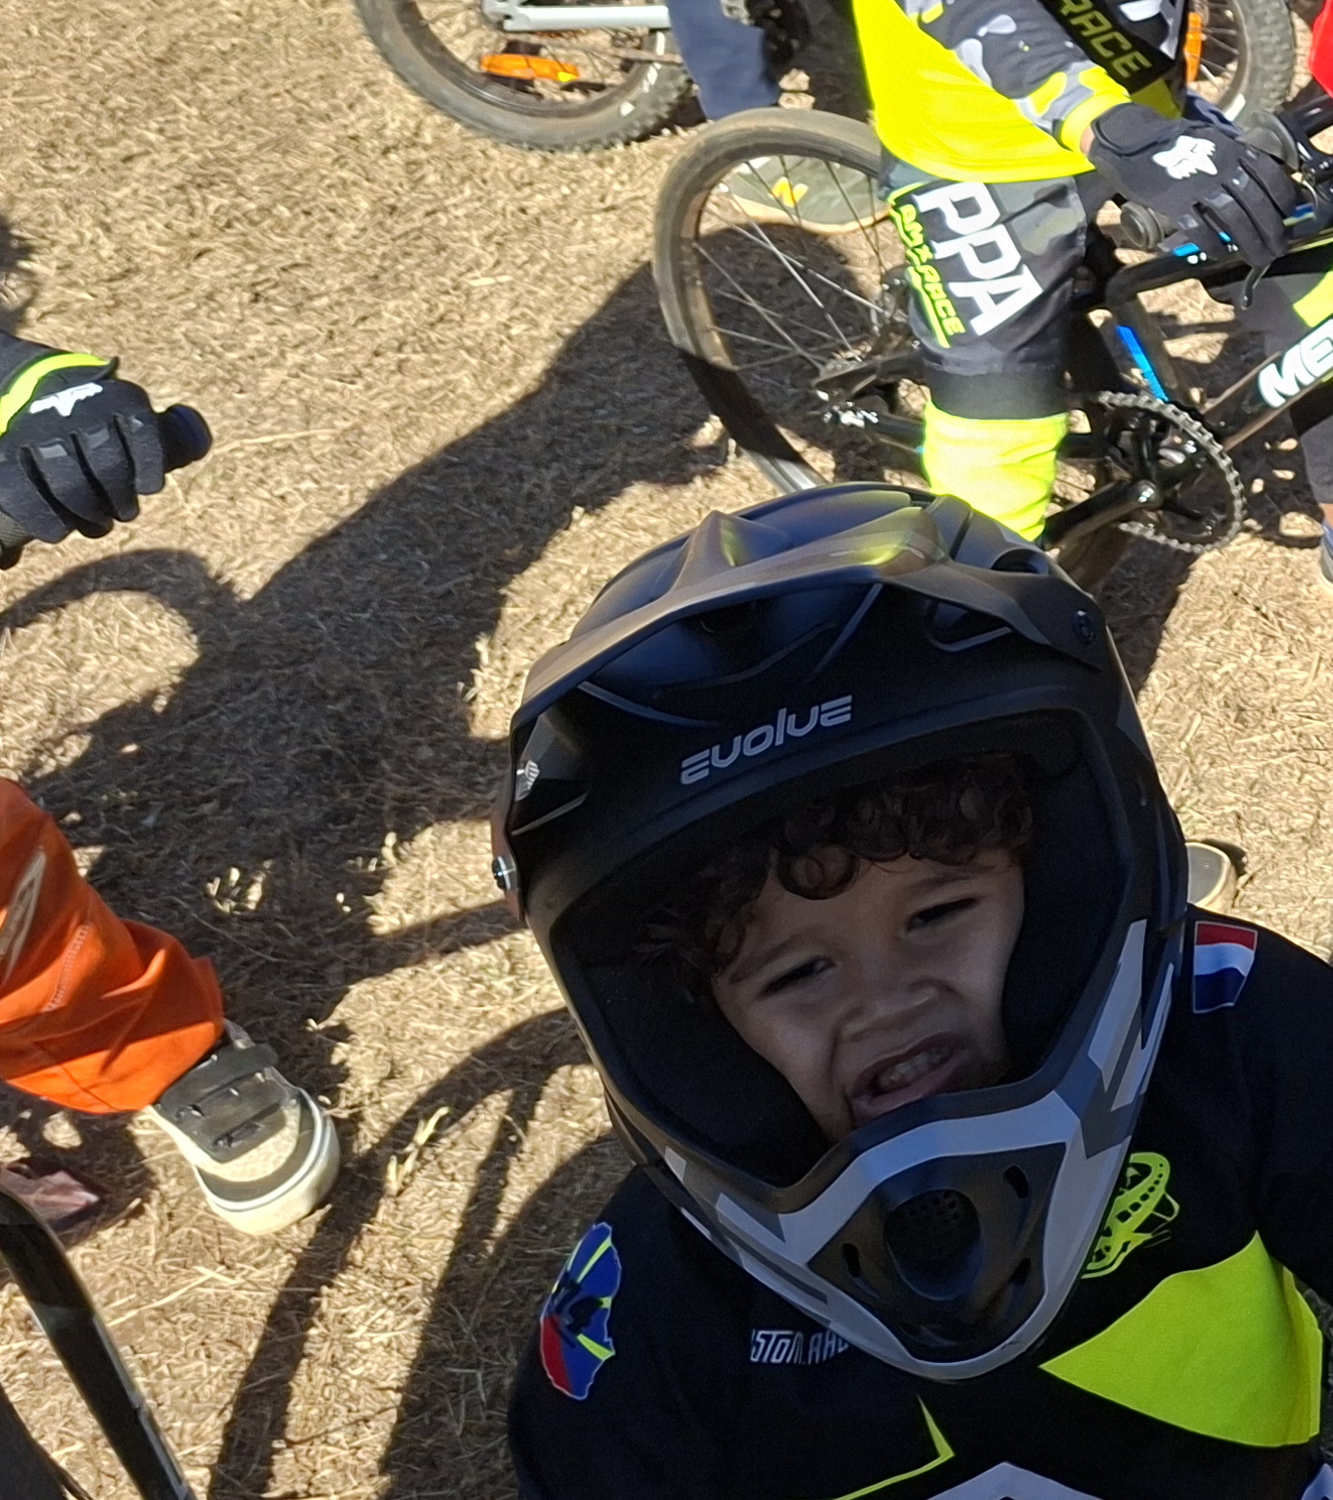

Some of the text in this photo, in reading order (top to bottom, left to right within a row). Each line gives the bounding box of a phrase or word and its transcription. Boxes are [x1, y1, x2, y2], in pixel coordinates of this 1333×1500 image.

[898, 203, 966, 337] BMX RACE
[911, 181, 1044, 337] PPA
